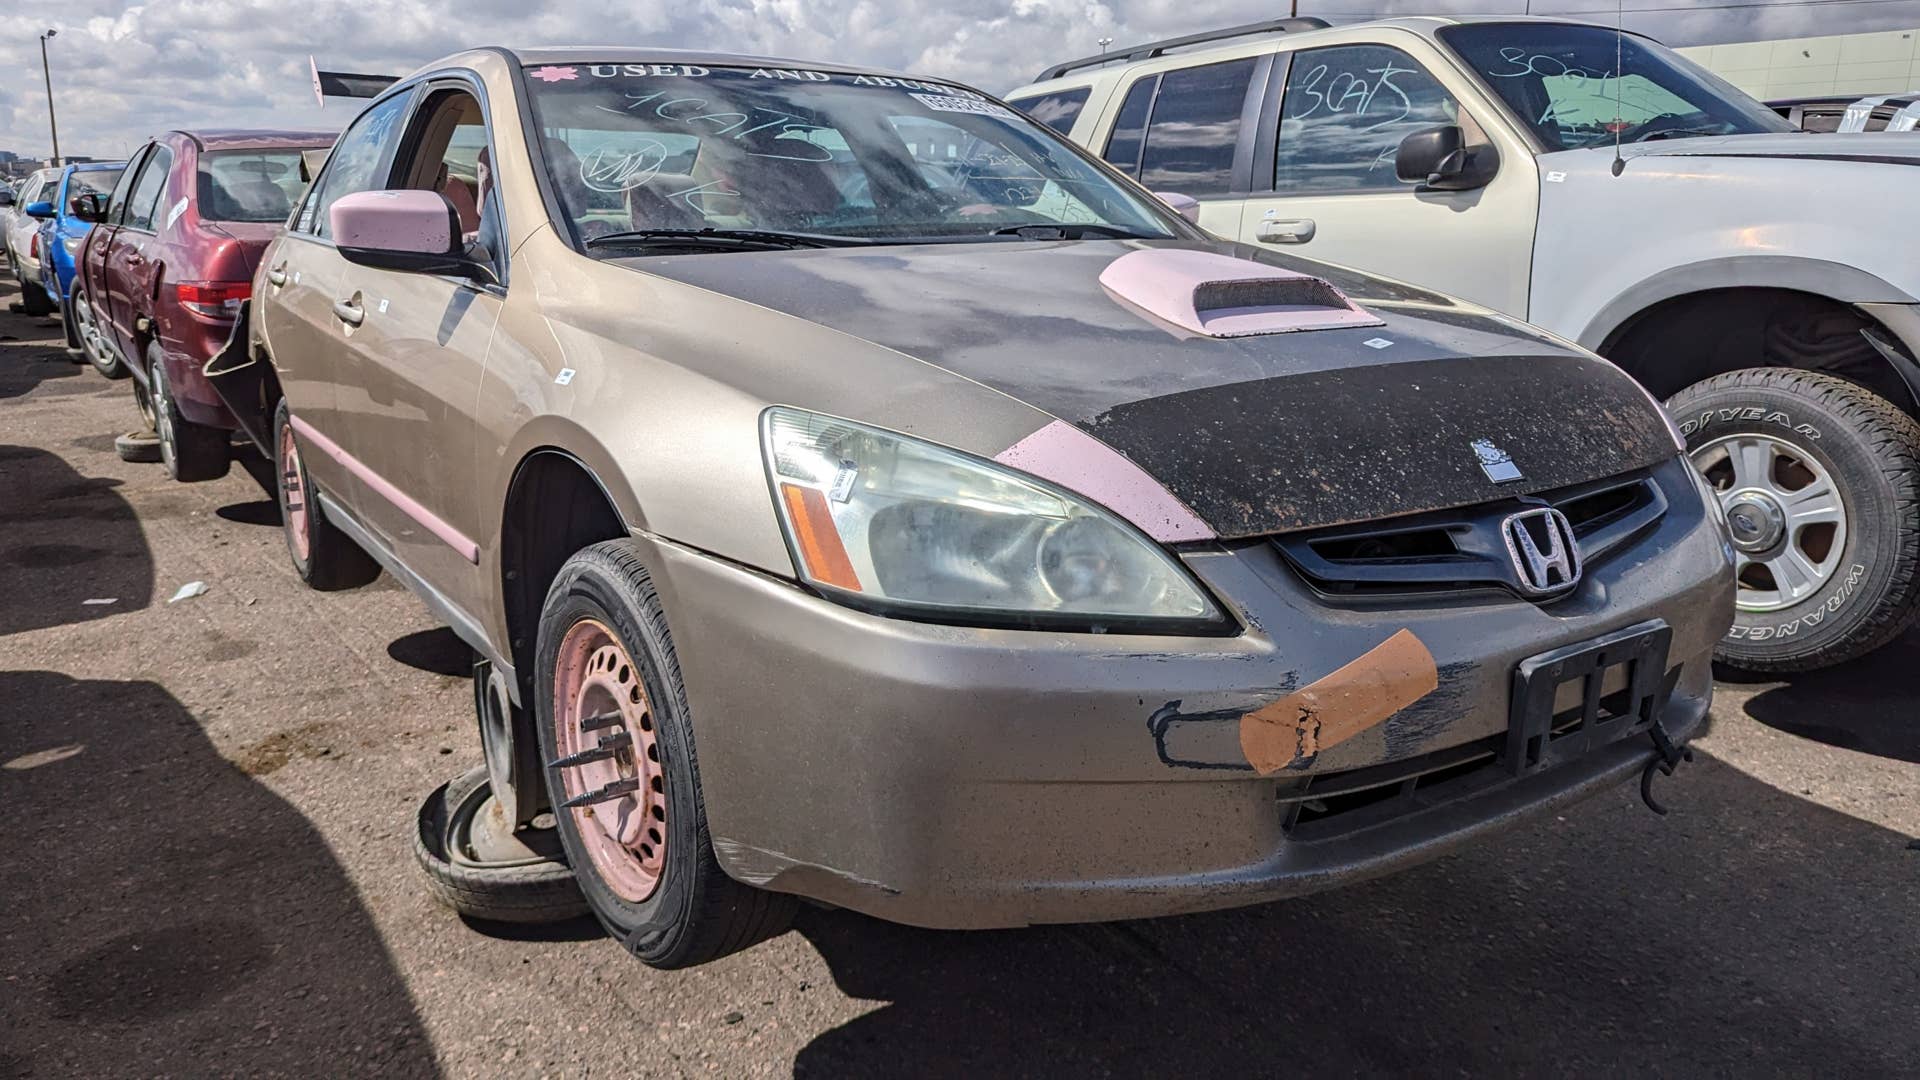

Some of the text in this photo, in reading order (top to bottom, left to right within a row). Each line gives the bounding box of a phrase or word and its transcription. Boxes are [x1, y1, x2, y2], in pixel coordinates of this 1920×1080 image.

[588, 64, 987, 100] USED AND ABUSED
